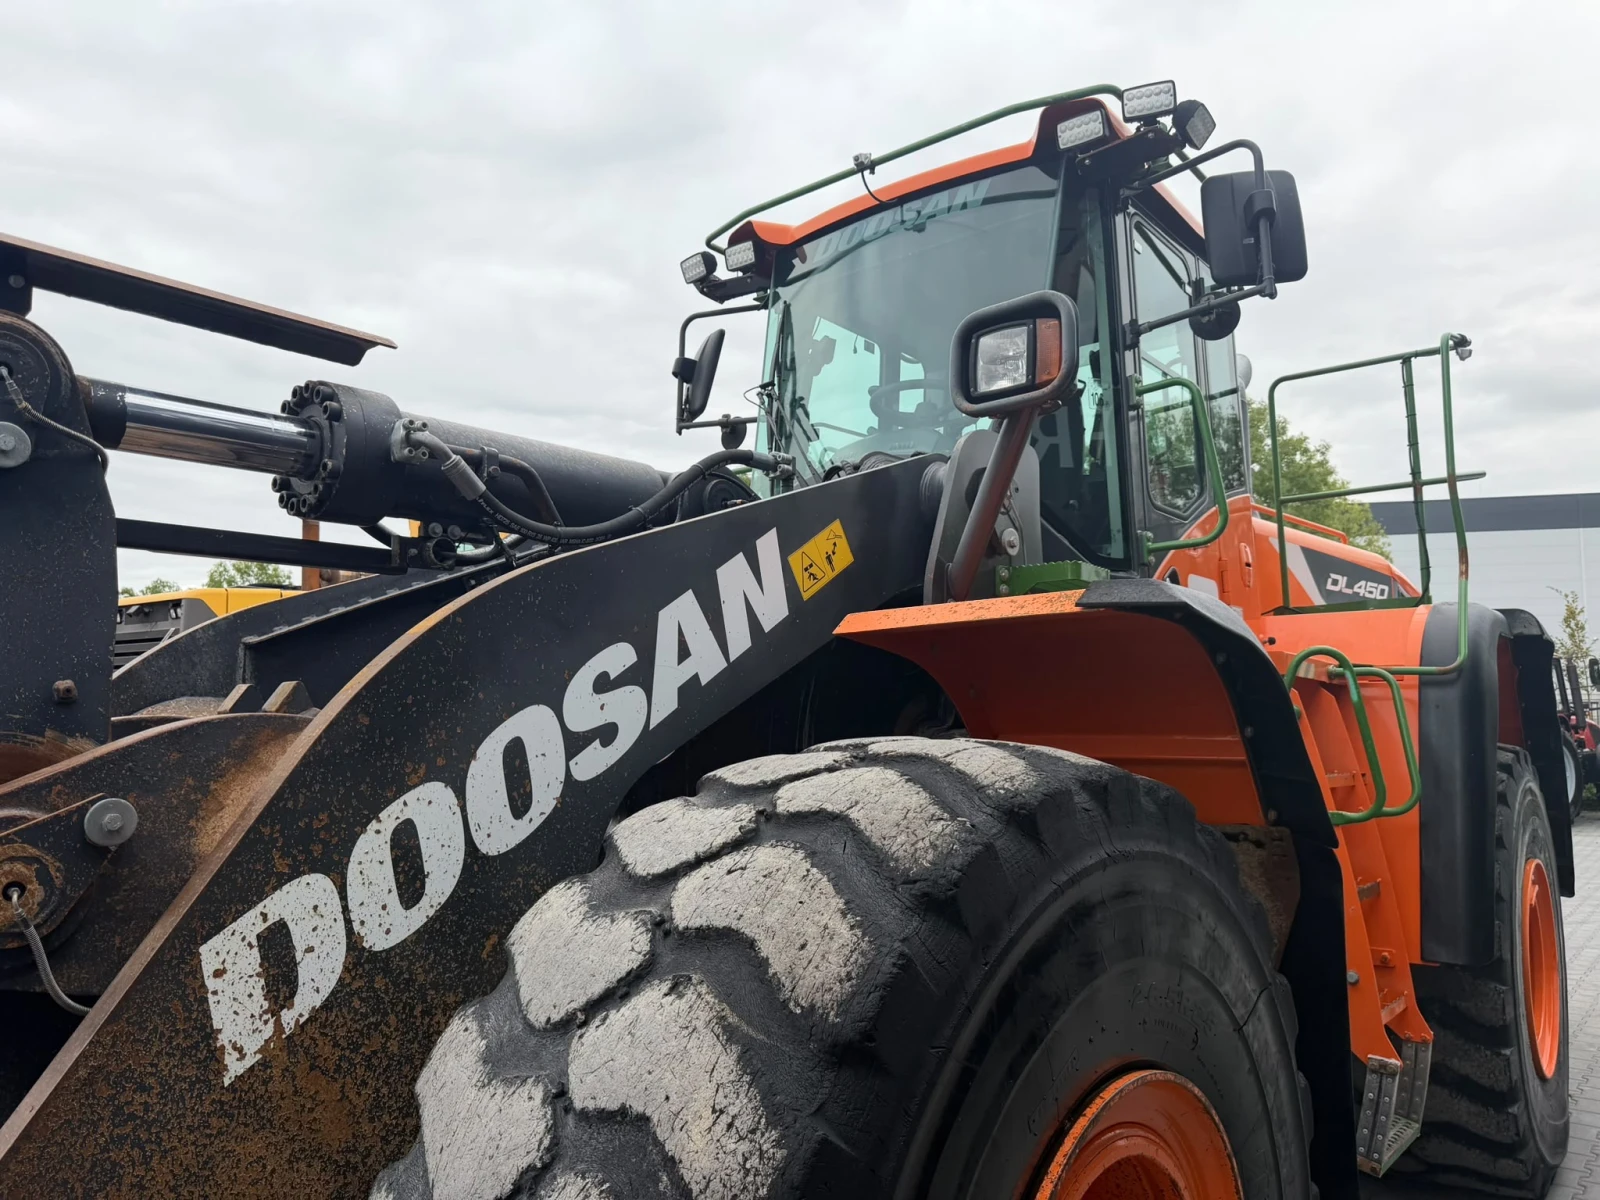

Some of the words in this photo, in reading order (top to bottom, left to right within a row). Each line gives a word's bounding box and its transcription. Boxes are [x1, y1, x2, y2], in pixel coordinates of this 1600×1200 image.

[812, 177, 992, 264] DOOSAN
[1325, 572, 1389, 600] DL450
[200, 526, 790, 1087] DOOSAN
